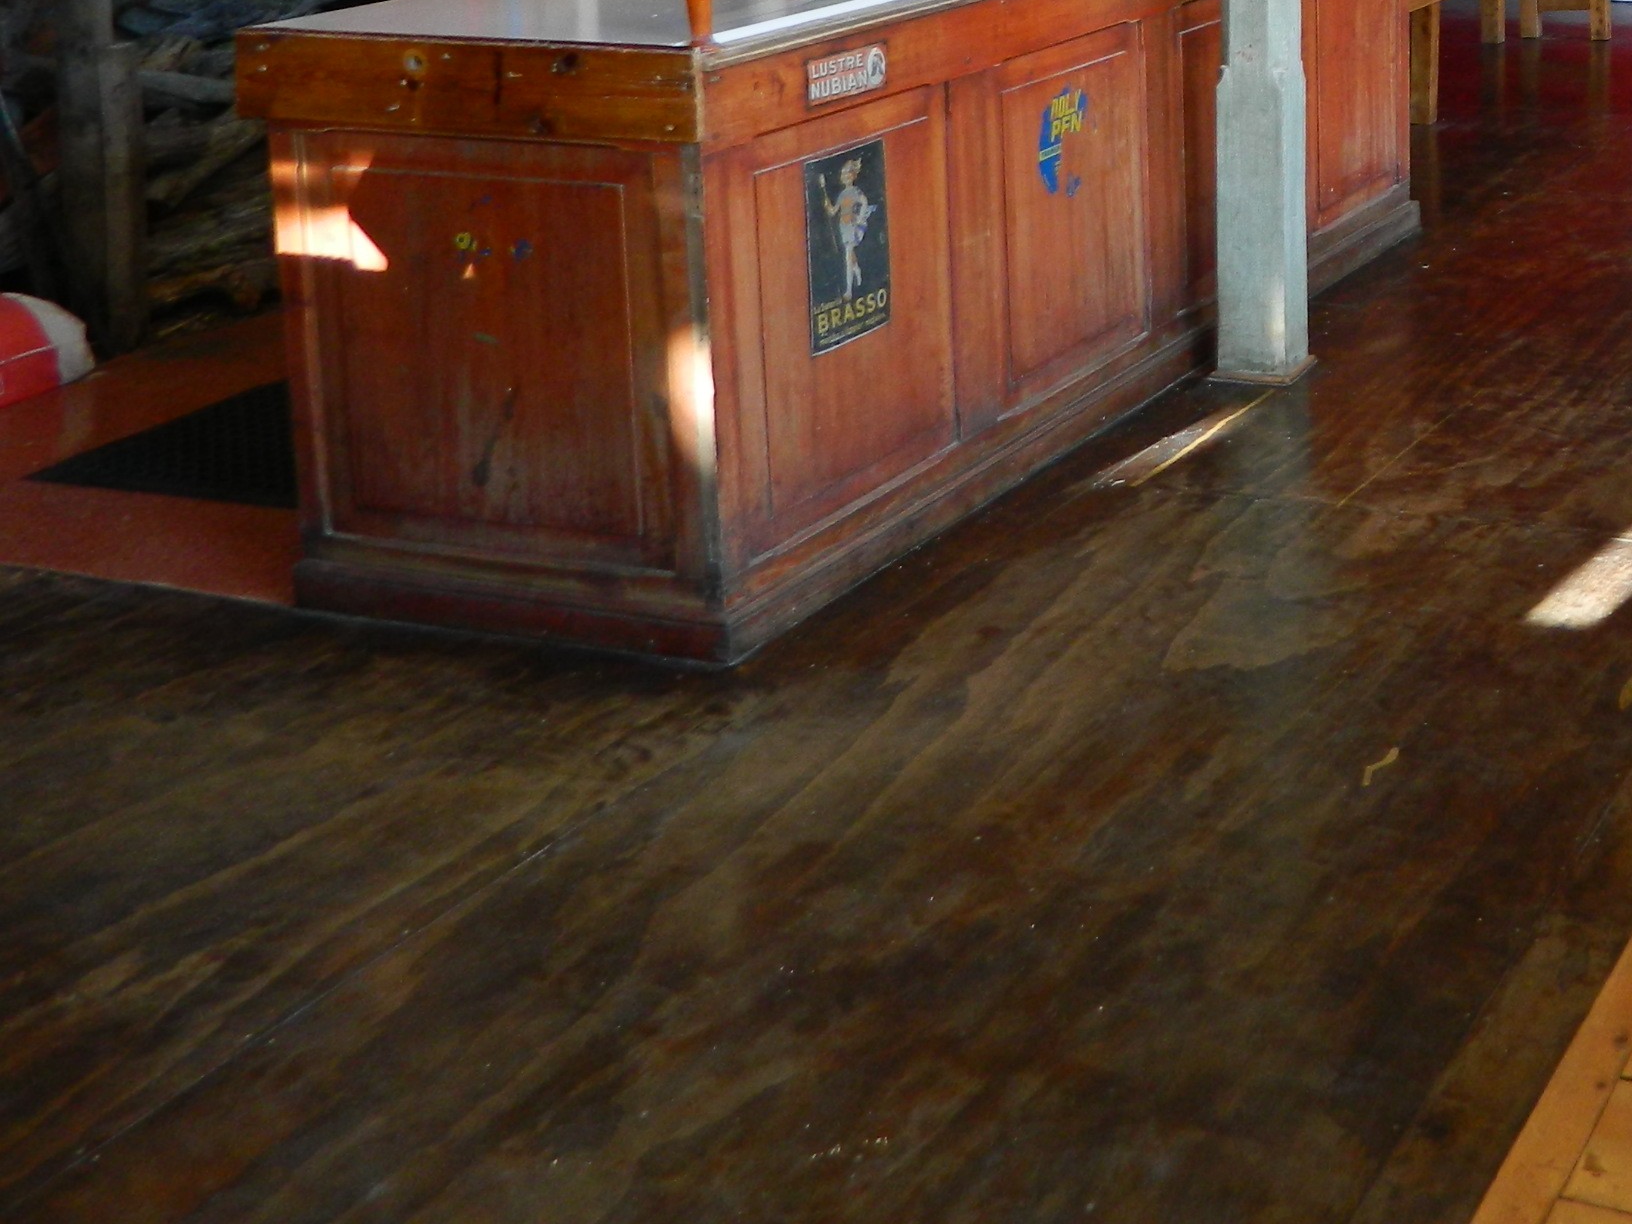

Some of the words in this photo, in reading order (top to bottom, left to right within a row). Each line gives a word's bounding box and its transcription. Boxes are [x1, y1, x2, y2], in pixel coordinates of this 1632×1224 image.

[811, 53, 864, 79] LUSTRE
[811, 69, 868, 101] NUBIAN
[817, 288, 888, 335] BRASSO
